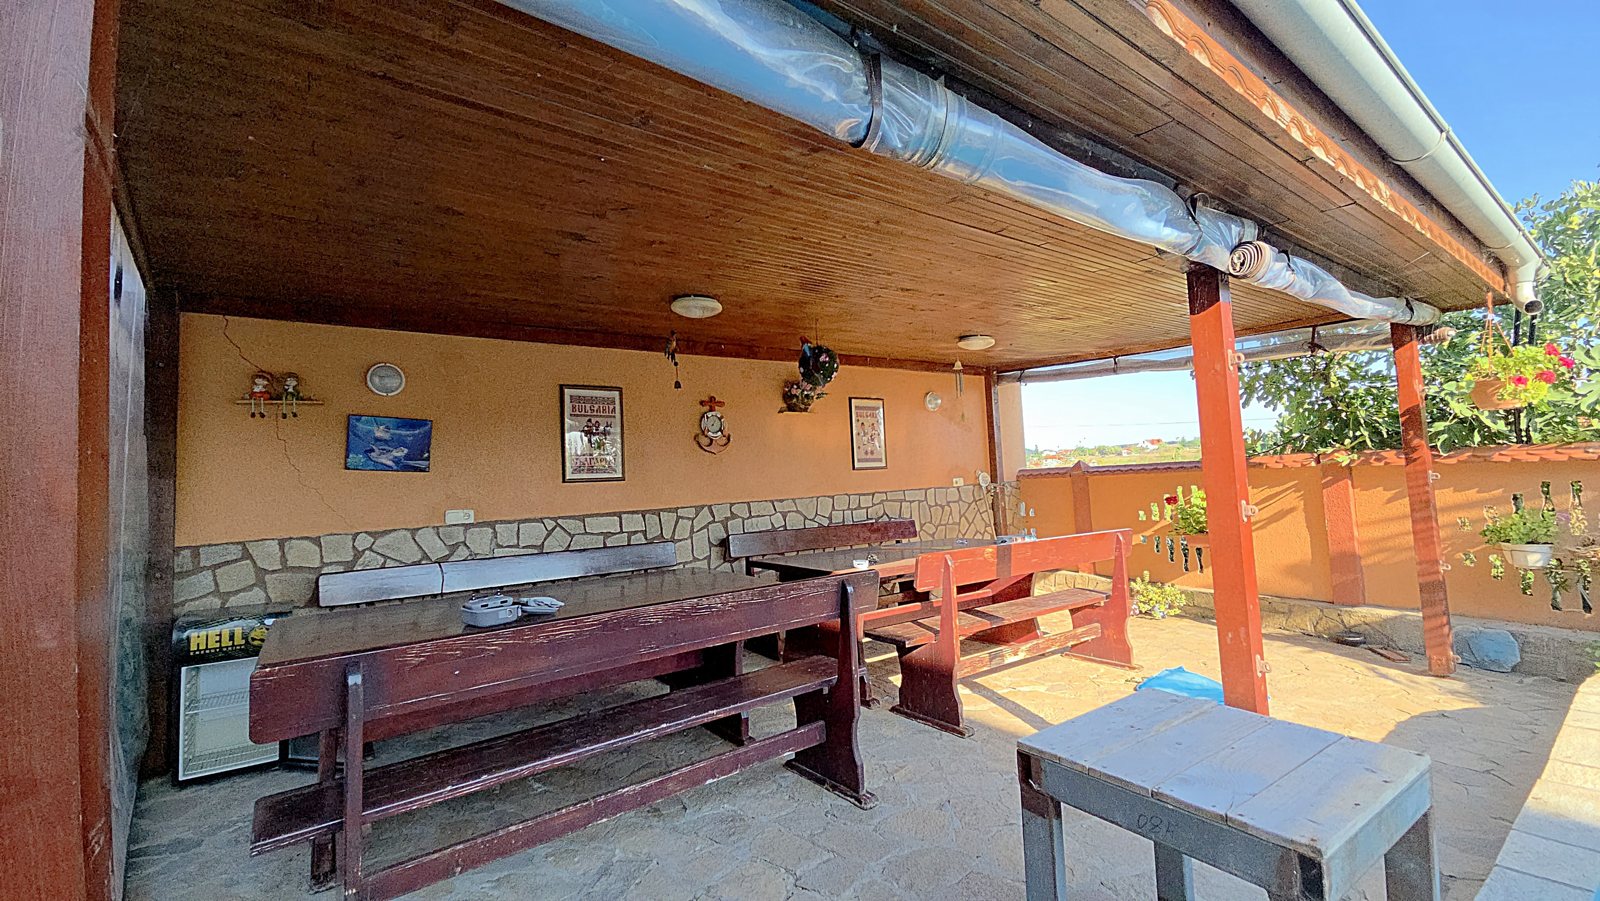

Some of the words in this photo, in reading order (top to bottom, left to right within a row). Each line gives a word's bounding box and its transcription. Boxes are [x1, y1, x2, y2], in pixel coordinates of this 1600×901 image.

[571, 403, 616, 414] BULGARIA
[855, 411, 879, 419] BULGARI
[190, 627, 245, 651] HELL
